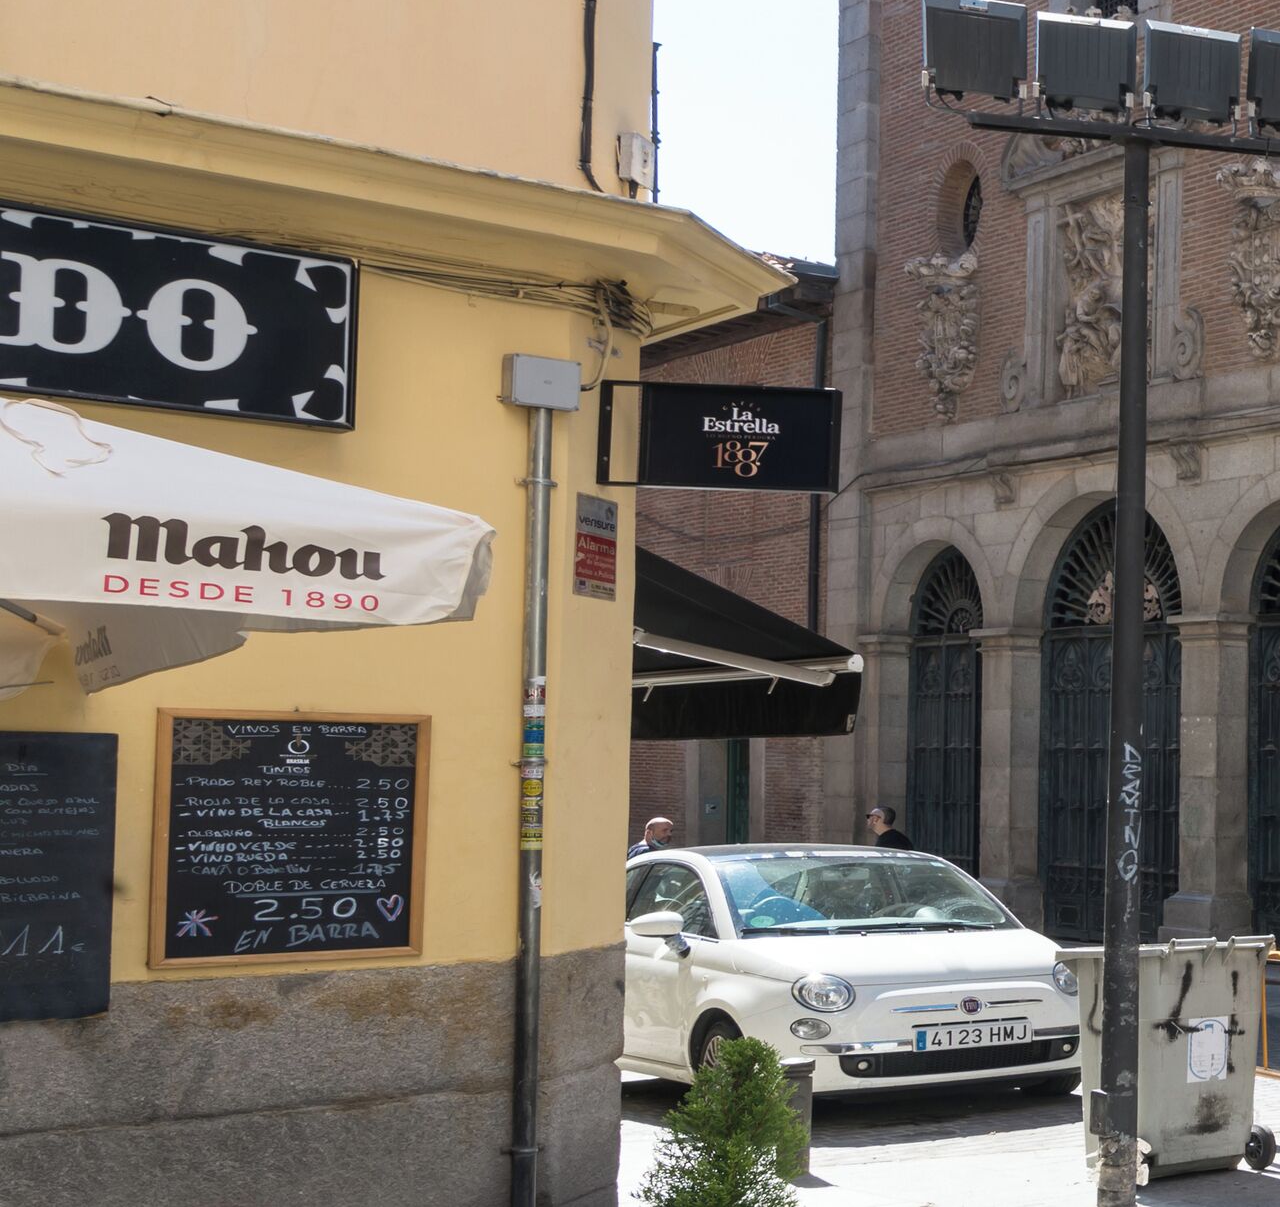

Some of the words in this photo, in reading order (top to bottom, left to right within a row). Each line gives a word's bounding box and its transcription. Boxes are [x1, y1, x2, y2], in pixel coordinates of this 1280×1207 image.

[732, 407, 753, 421] La
[702, 416, 780, 434] Estrella
[712, 440, 769, 477] 1887
[578, 536, 615, 555] Alarma
[102, 574, 255, 604] DESDE
[281, 588, 380, 612] 1890
[228, 725, 280, 734] VINOS
[292, 725, 312, 733] EN
[318, 725, 367, 734] BARRA
[186, 777, 235, 787] PRADO
[241, 778, 272, 787] REY
[356, 778, 410, 791] 2.50
[235, 797, 261, 806] DE
[355, 797, 408, 809] 2.50
[240, 808, 264, 817] DE
[268, 807, 293, 816] LA
[357, 809, 410, 822] 1.75
[257, 818, 327, 828] BLANCOS
[356, 826, 404, 836] 2.50
[240, 841, 297, 851] VERDE
[353, 837, 404, 848] 2.50
[236, 853, 288, 862] RUEDA
[356, 849, 401, 859] 2.50
[223, 880, 283, 893] DOBLE
[288, 880, 313, 890] DE
[320, 879, 386, 889] CERVEZA
[254, 897, 358, 922] 2.50
[234, 926, 273, 954] EN
[286, 921, 380, 948] BARRA
[931, 1028, 982, 1047] 4123
[990, 1024, 1027, 1043] HMJ
